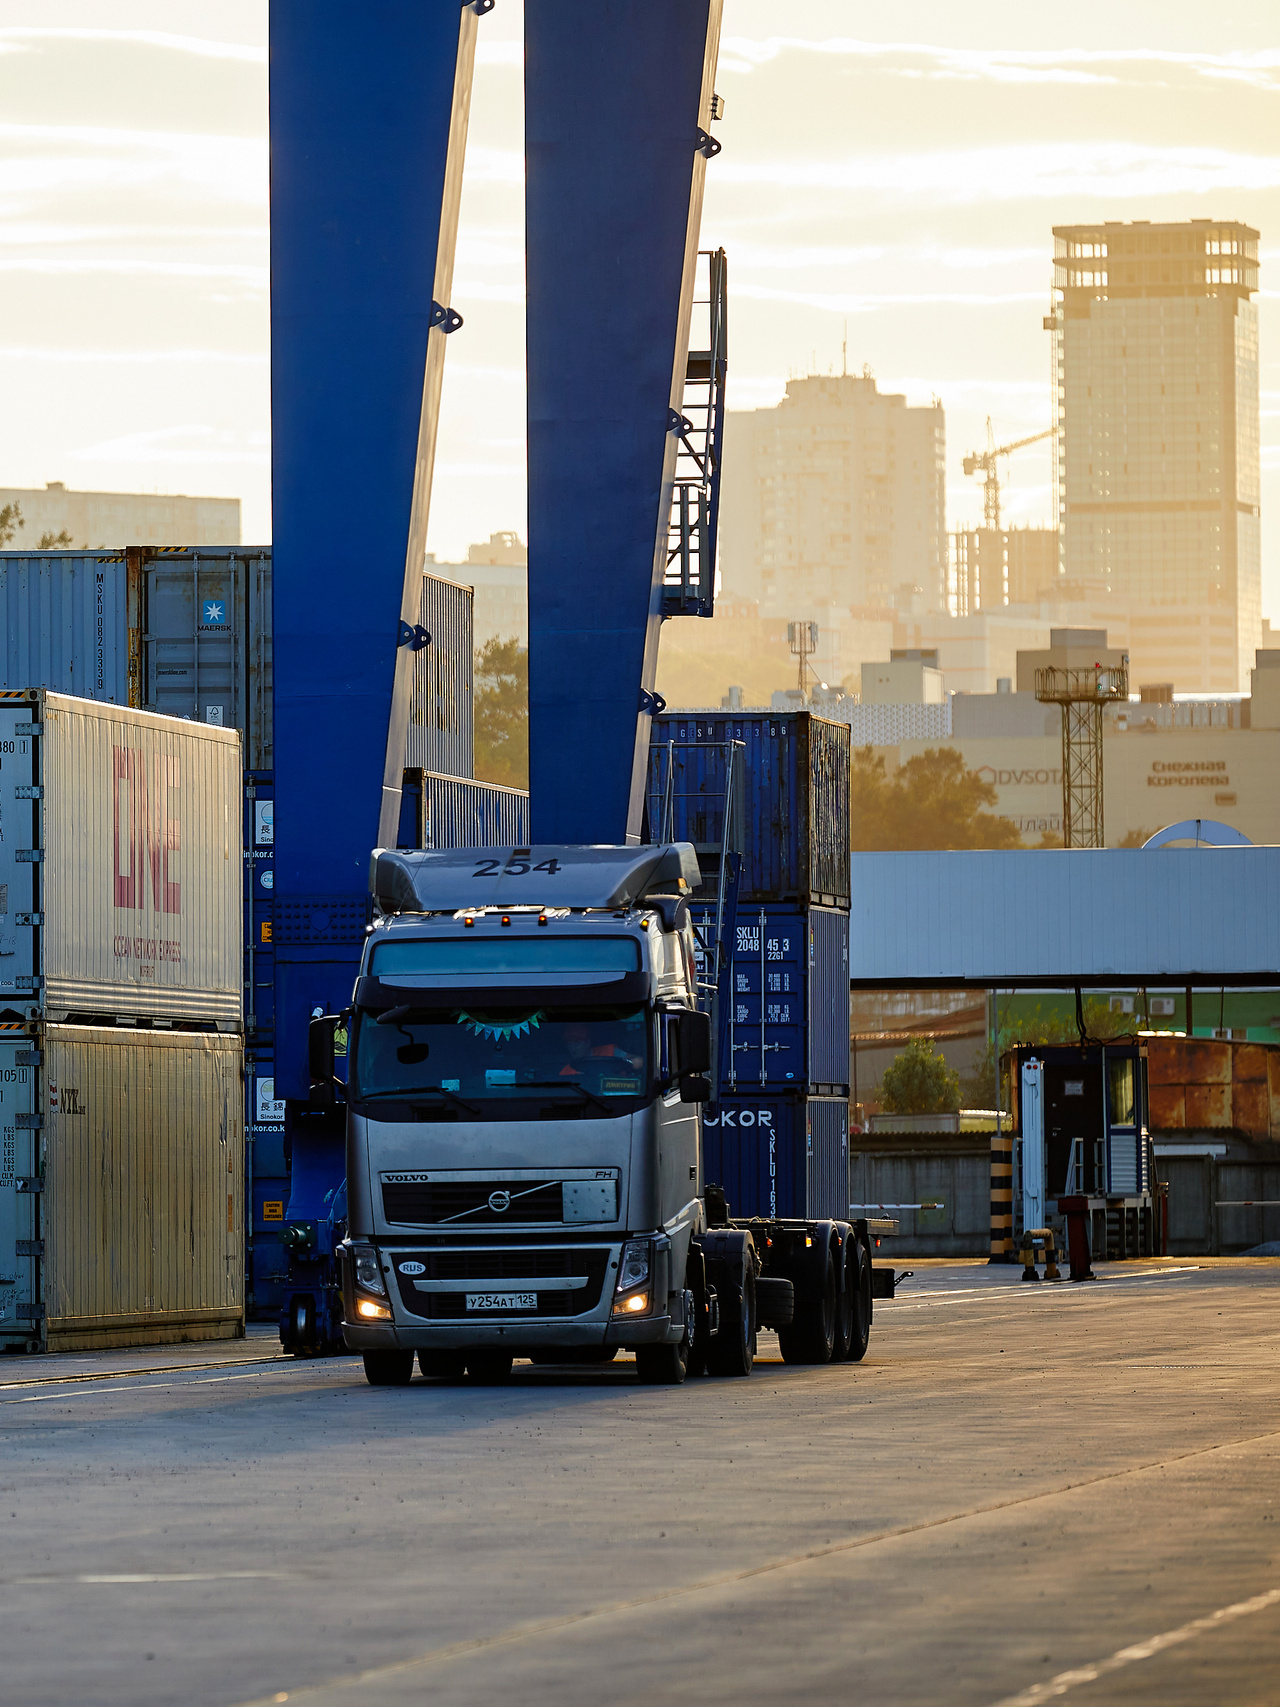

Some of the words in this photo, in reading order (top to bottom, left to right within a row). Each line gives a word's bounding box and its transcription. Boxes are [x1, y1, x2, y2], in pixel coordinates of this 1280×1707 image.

[112, 744, 181, 914] ONE
[472, 858, 562, 878] 254
[736, 926, 759, 939] SKLU
[737, 939, 760, 951] 2048
[767, 939, 779, 951] 45
[3, 1164, 15, 1172] LBS
[385, 1174, 429, 1182] VOLVO
[402, 1264, 424, 1273] RUS
[517, 1295, 534, 1304] 125
